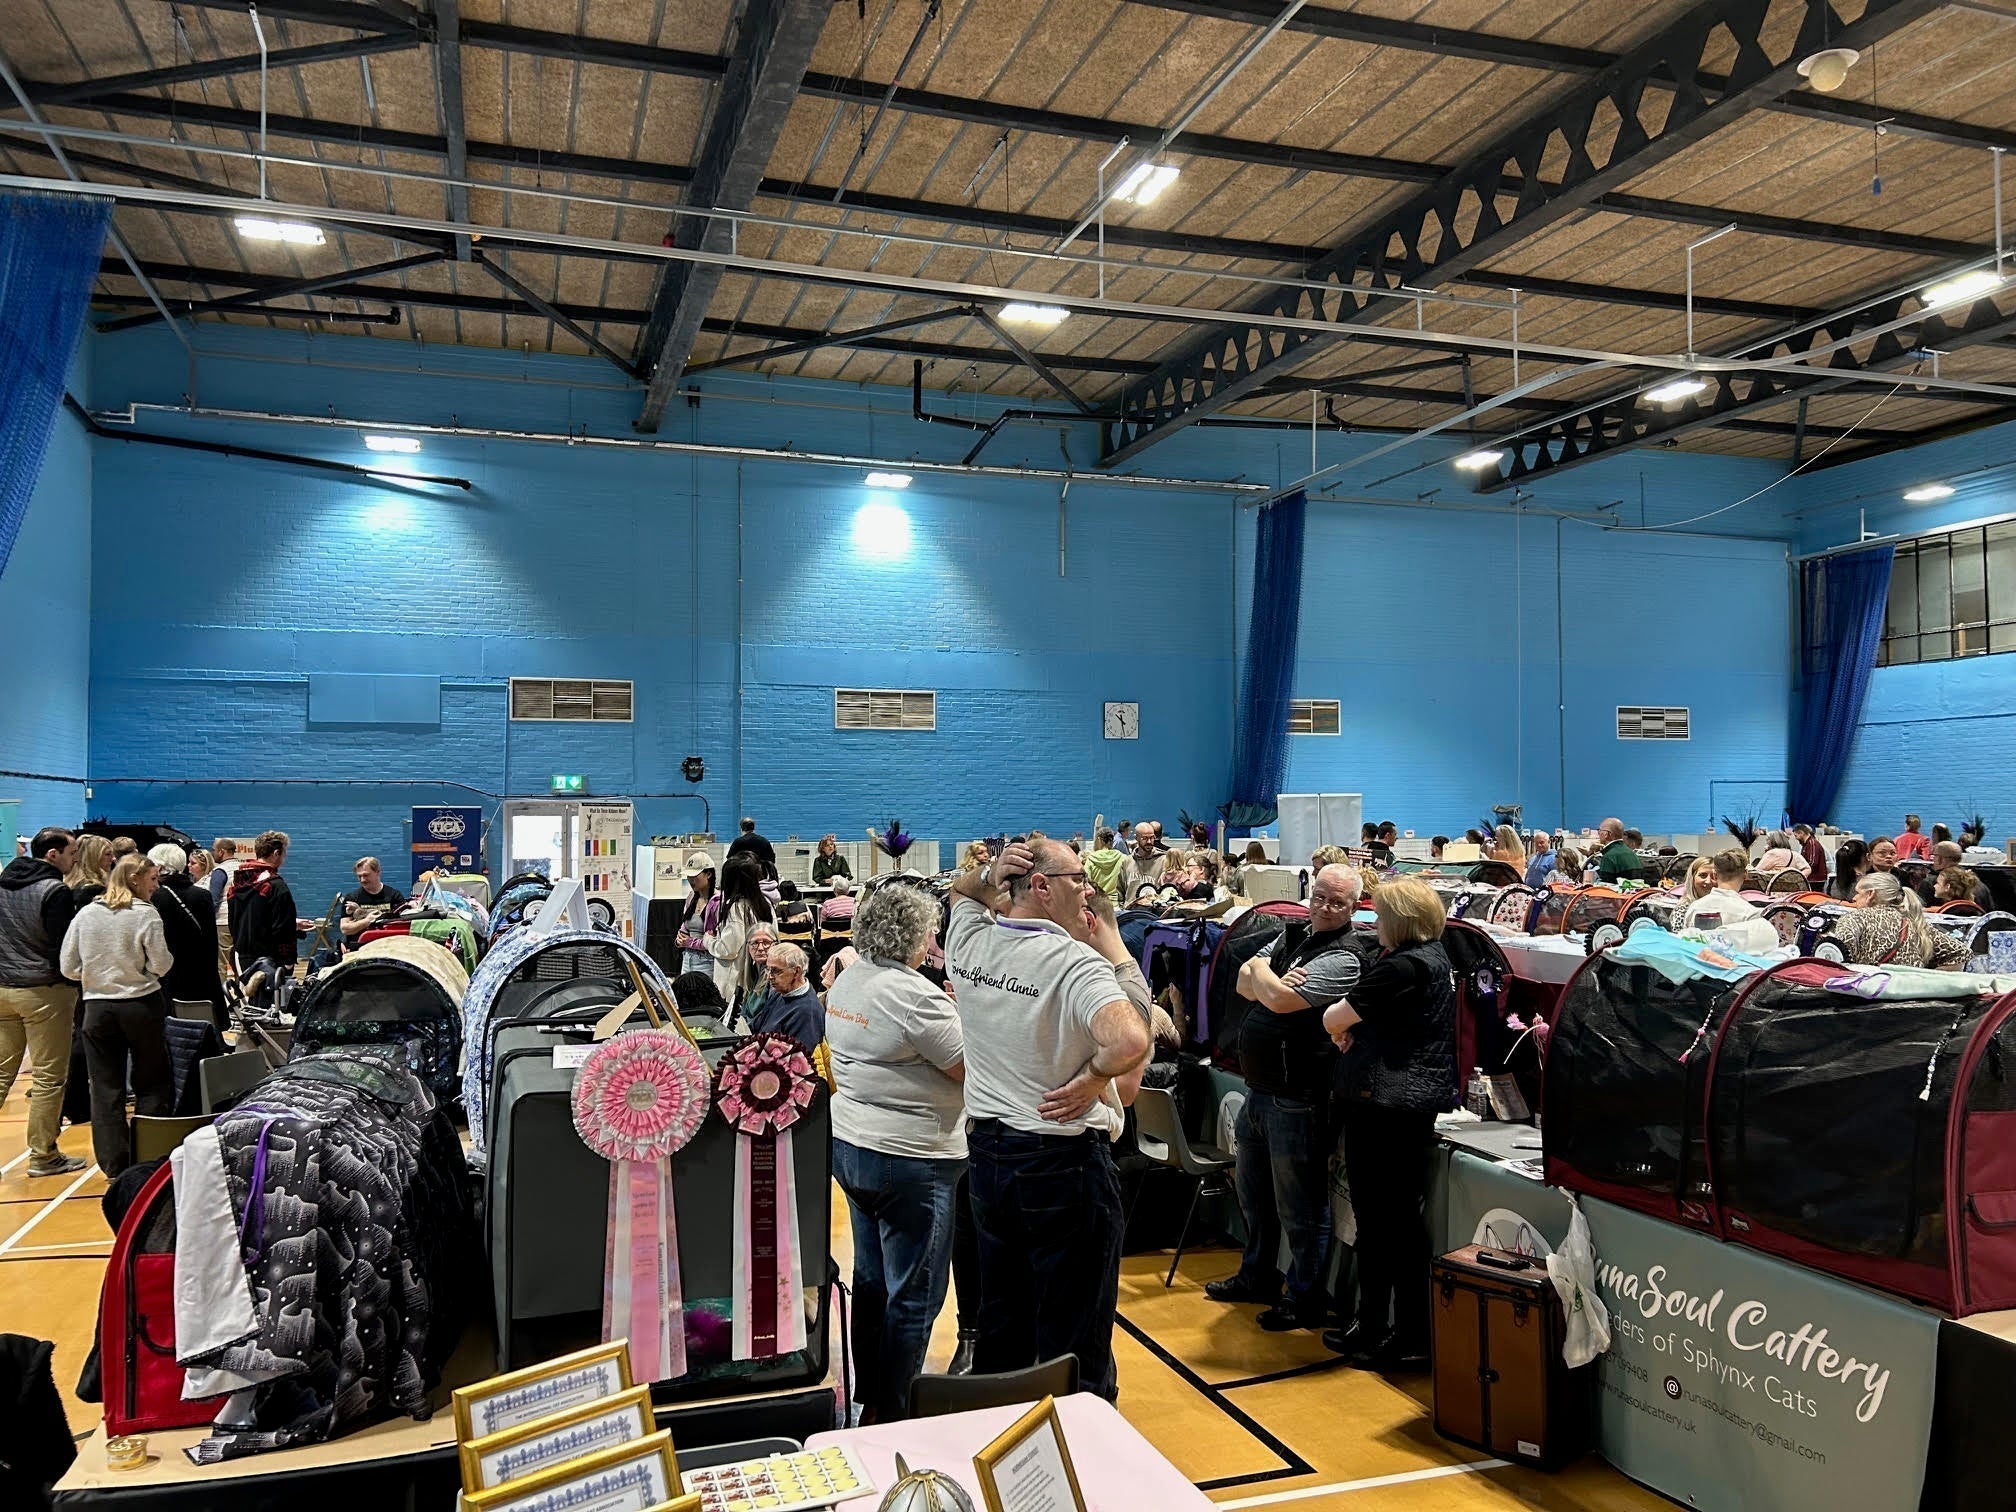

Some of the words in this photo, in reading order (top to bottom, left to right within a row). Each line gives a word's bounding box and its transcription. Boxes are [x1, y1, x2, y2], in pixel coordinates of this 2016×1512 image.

[431, 821, 463, 833] TICA
[237, 843, 254, 854] Plu
[1006, 977, 1040, 998] Annie
[1595, 1258, 1724, 1333] unaSoul
[1727, 1299, 1892, 1423] Cattery
[1607, 1309, 1645, 1345] eders
[1653, 1332, 1677, 1356] of
[1683, 1338, 1756, 1393] Sphynx
[1764, 1375, 1818, 1418] Cats
